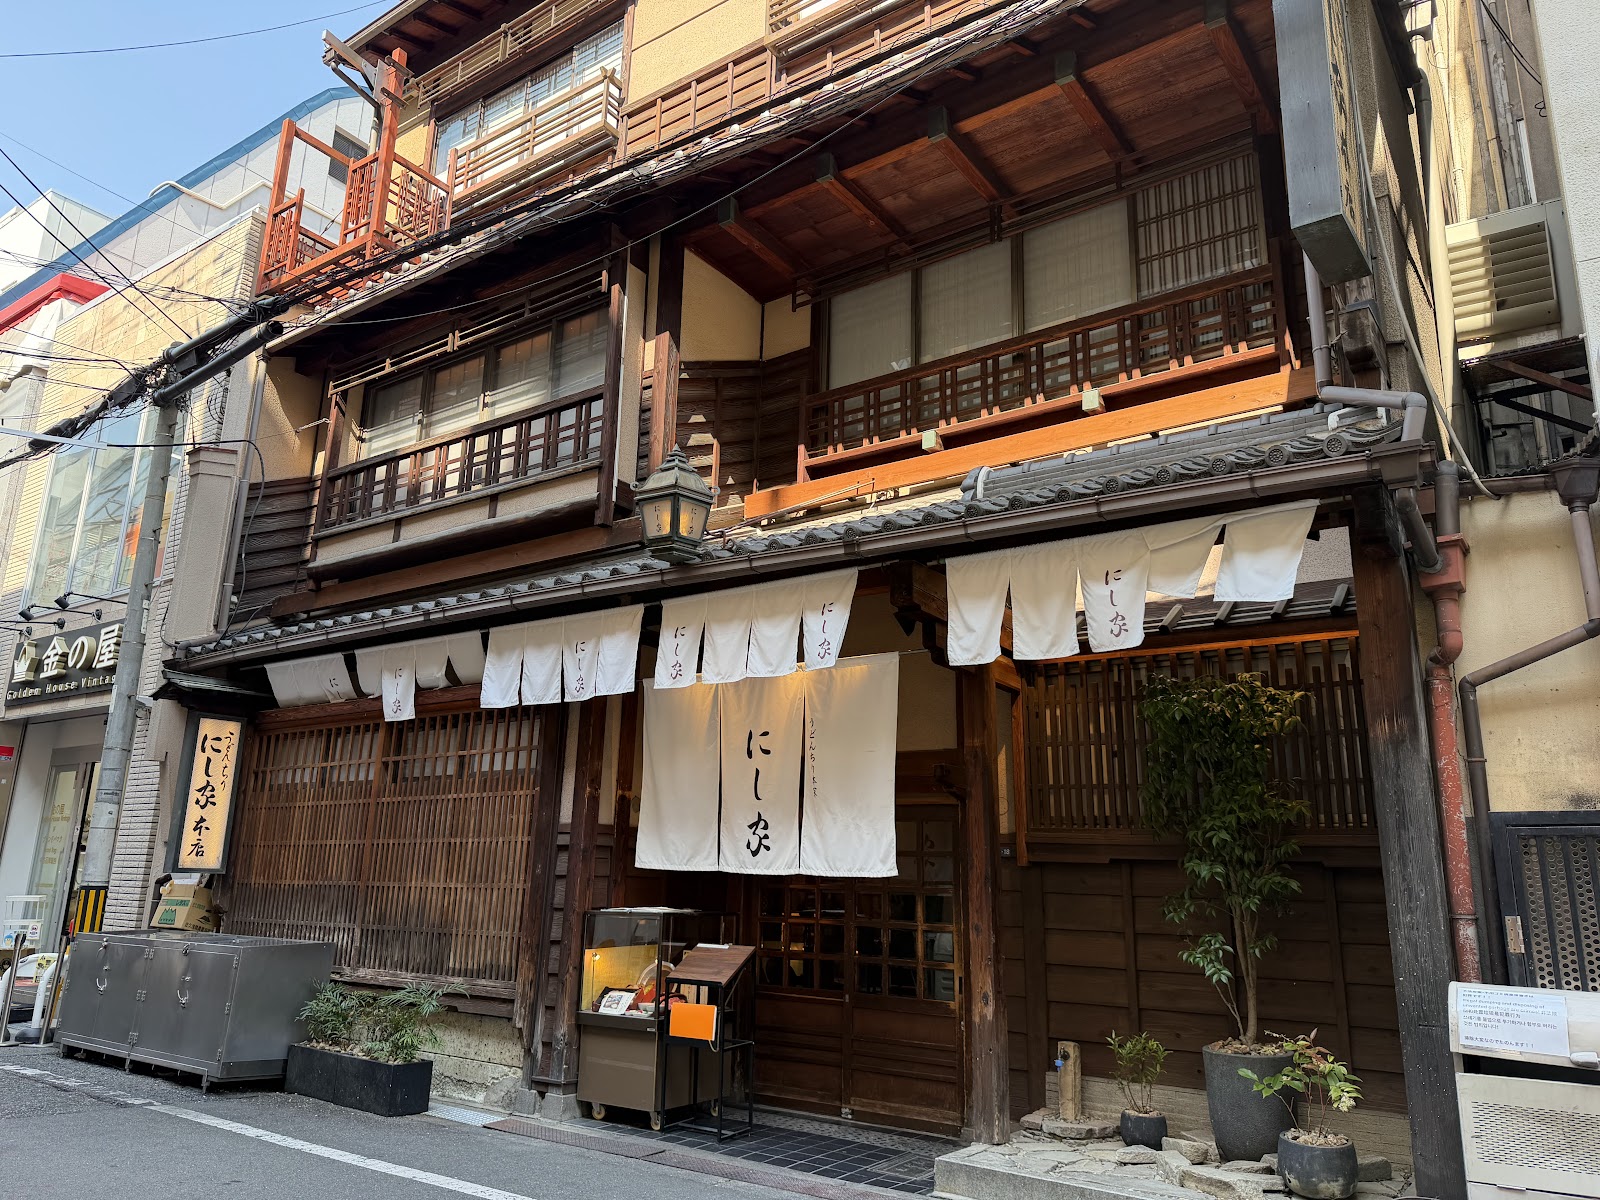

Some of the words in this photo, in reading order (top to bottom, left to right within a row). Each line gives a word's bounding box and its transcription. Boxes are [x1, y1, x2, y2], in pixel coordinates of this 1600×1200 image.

[817, 602, 834, 660] にし家
[1105, 569, 1129, 638] にし家
[40, 623, 123, 679] 金の屋
[574, 641, 586, 693] にし家
[670, 626, 686, 680] にし家
[6, 687, 42, 700] Golden
[45, 681, 79, 694] House
[392, 668, 402, 714] にし家
[746, 729, 771, 858] にし家
